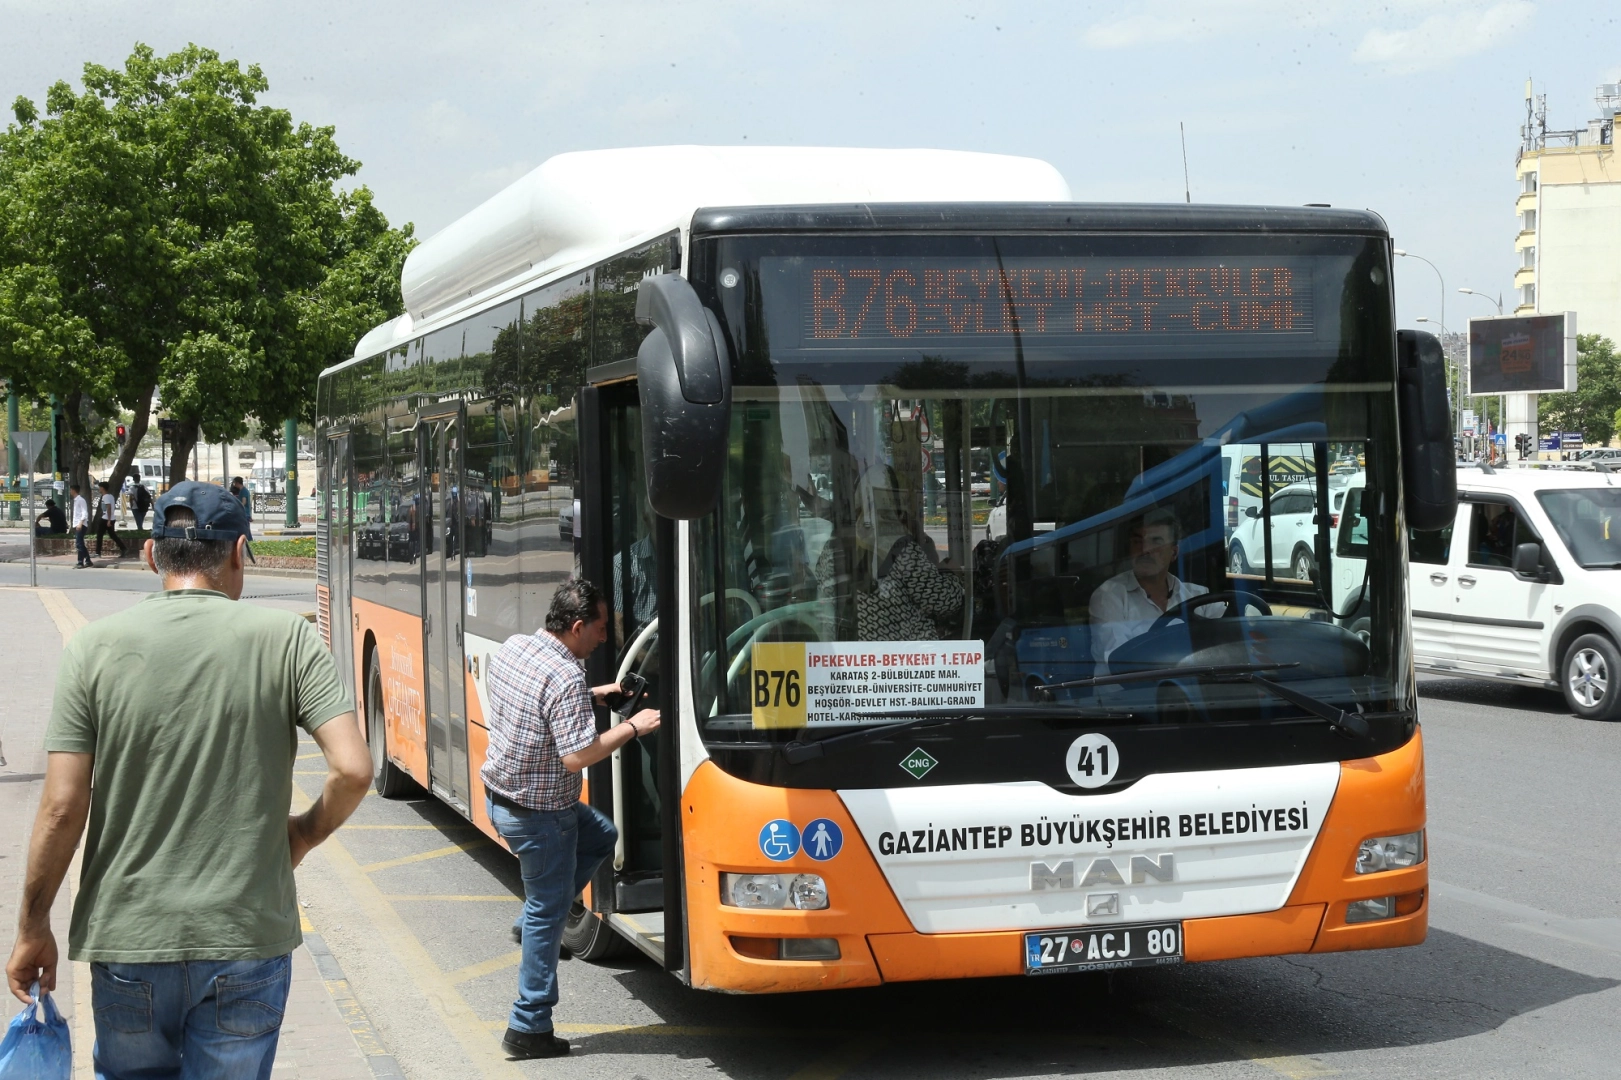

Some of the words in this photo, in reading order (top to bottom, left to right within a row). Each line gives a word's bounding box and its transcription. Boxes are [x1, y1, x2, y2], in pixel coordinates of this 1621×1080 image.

[813, 269, 918, 338] B76
[808, 651, 937, 668] İPEKEVLER-BEYKENT
[940, 651, 982, 666] 1.ETAP
[830, 671, 869, 682] KARATAŞ
[871, 668, 936, 680] 2-BÜLBÜLZADE
[938, 669, 961, 679] MAH.
[754, 669, 801, 708] B76
[807, 681, 982, 696] BEŞYÜZEVLER-ÜNİVERSİTE-CUMHURİYET
[814, 697, 887, 710] HOŞGÖR-DEVLET
[889, 696, 976, 708] HST.-BALIKLI-GRAND
[908, 758, 930, 769] CNG
[1077, 745, 1109, 776] 41
[878, 822, 1012, 856] GAZİANTEP
[1020, 810, 1171, 849] BÜYÜKŞEHİR
[1178, 800, 1309, 838] BELEDİYESİ
[1029, 852, 1174, 891] MAN
[1040, 936, 1069, 964] 27
[1087, 931, 1131, 960] ACJ
[1147, 928, 1176, 955] 80
[1030, 953, 1040, 962] TR
[1078, 960, 1133, 972] DÖSMAN
